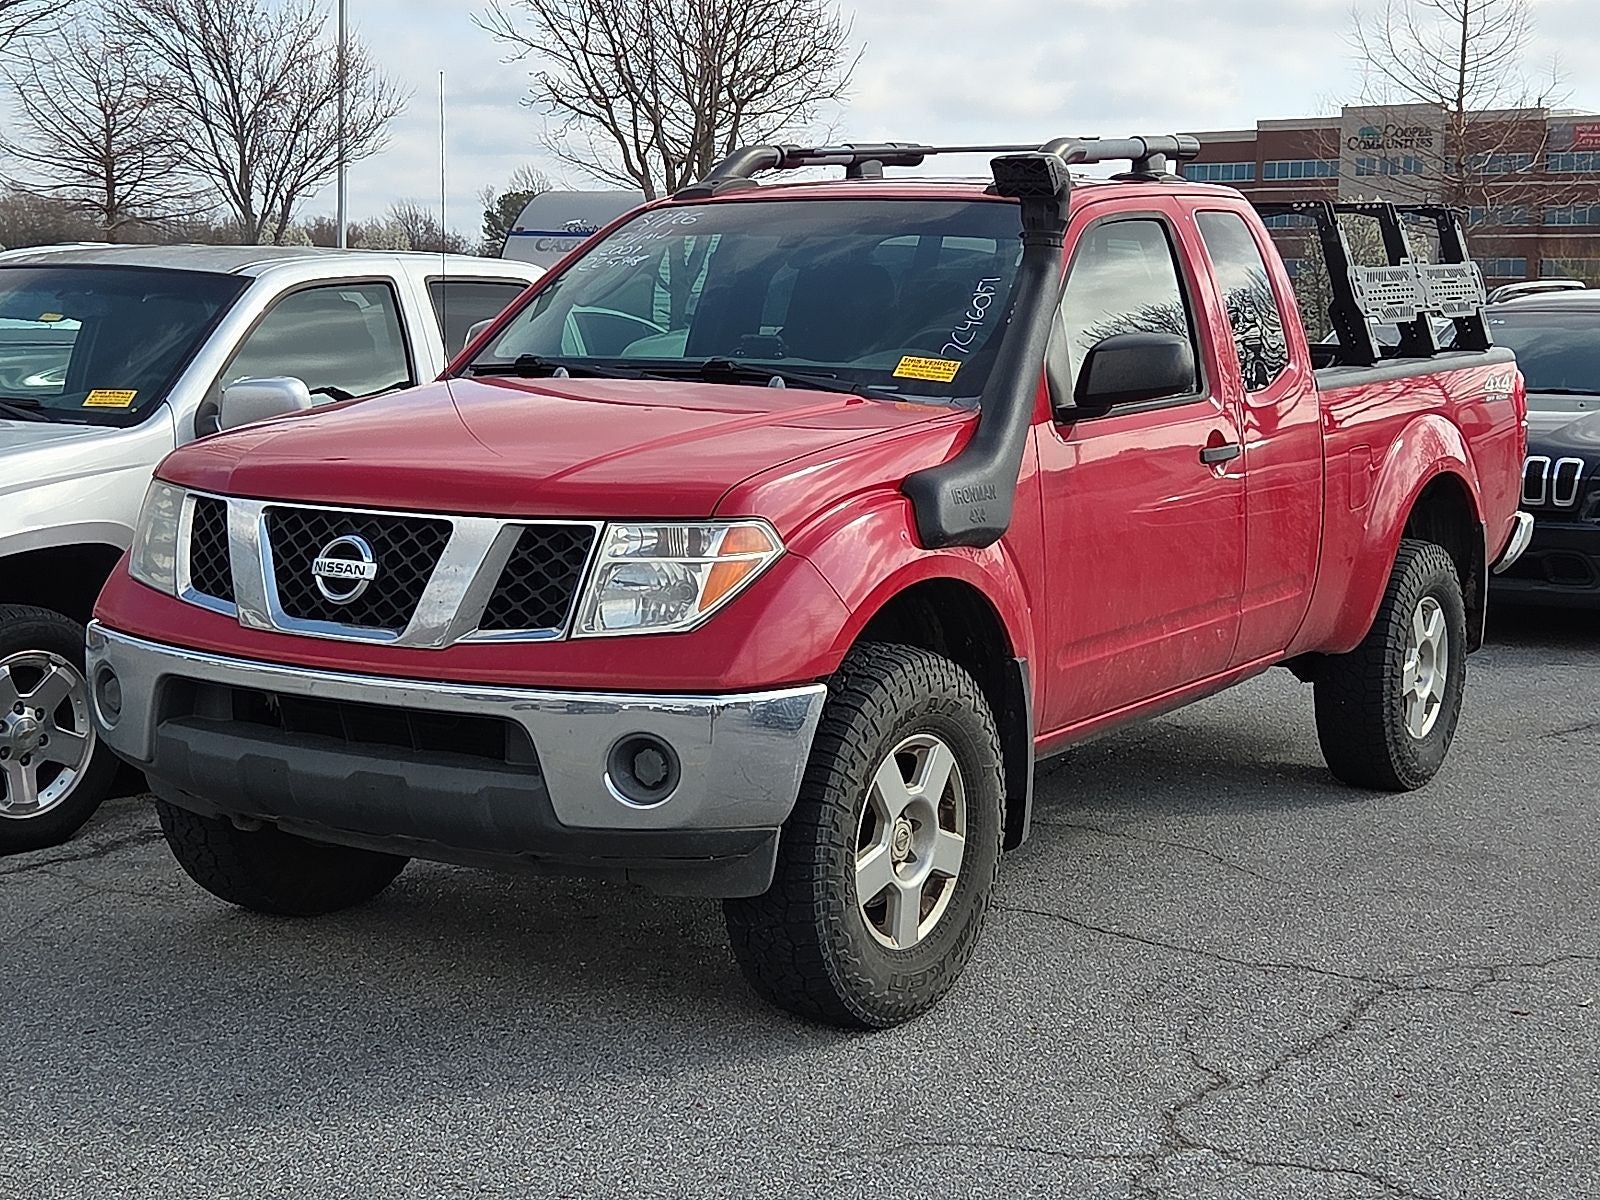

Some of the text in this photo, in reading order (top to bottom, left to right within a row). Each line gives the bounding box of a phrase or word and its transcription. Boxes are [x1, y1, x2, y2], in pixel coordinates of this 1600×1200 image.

[924, 360, 959, 368] VEHICLE
[951, 485, 997, 505] IRONMAN
[314, 560, 366, 576] NISSAN
